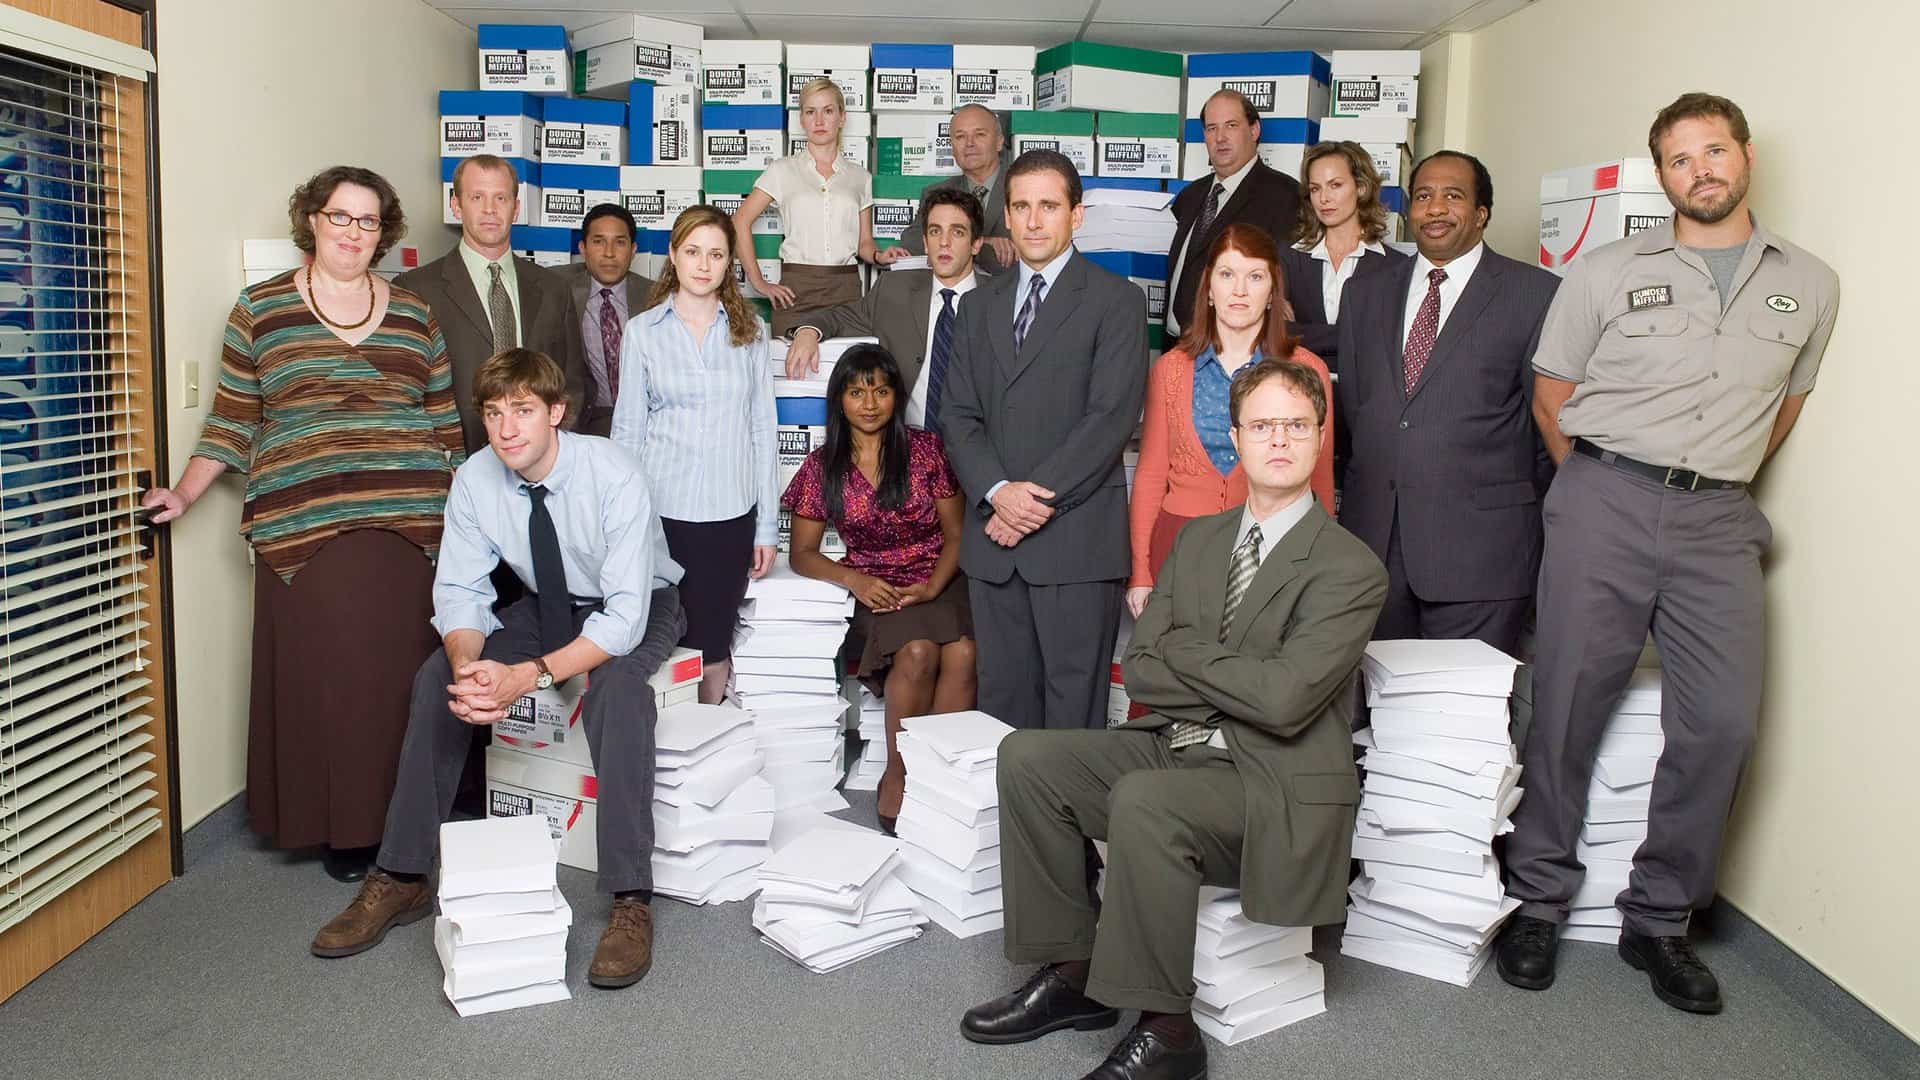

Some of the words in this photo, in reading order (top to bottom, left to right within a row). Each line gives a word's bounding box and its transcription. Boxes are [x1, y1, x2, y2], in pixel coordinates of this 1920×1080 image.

[488, 56, 522, 64] DUNDER
[779, 433, 805, 441] NDER
[493, 791, 529, 809] DUNDER
